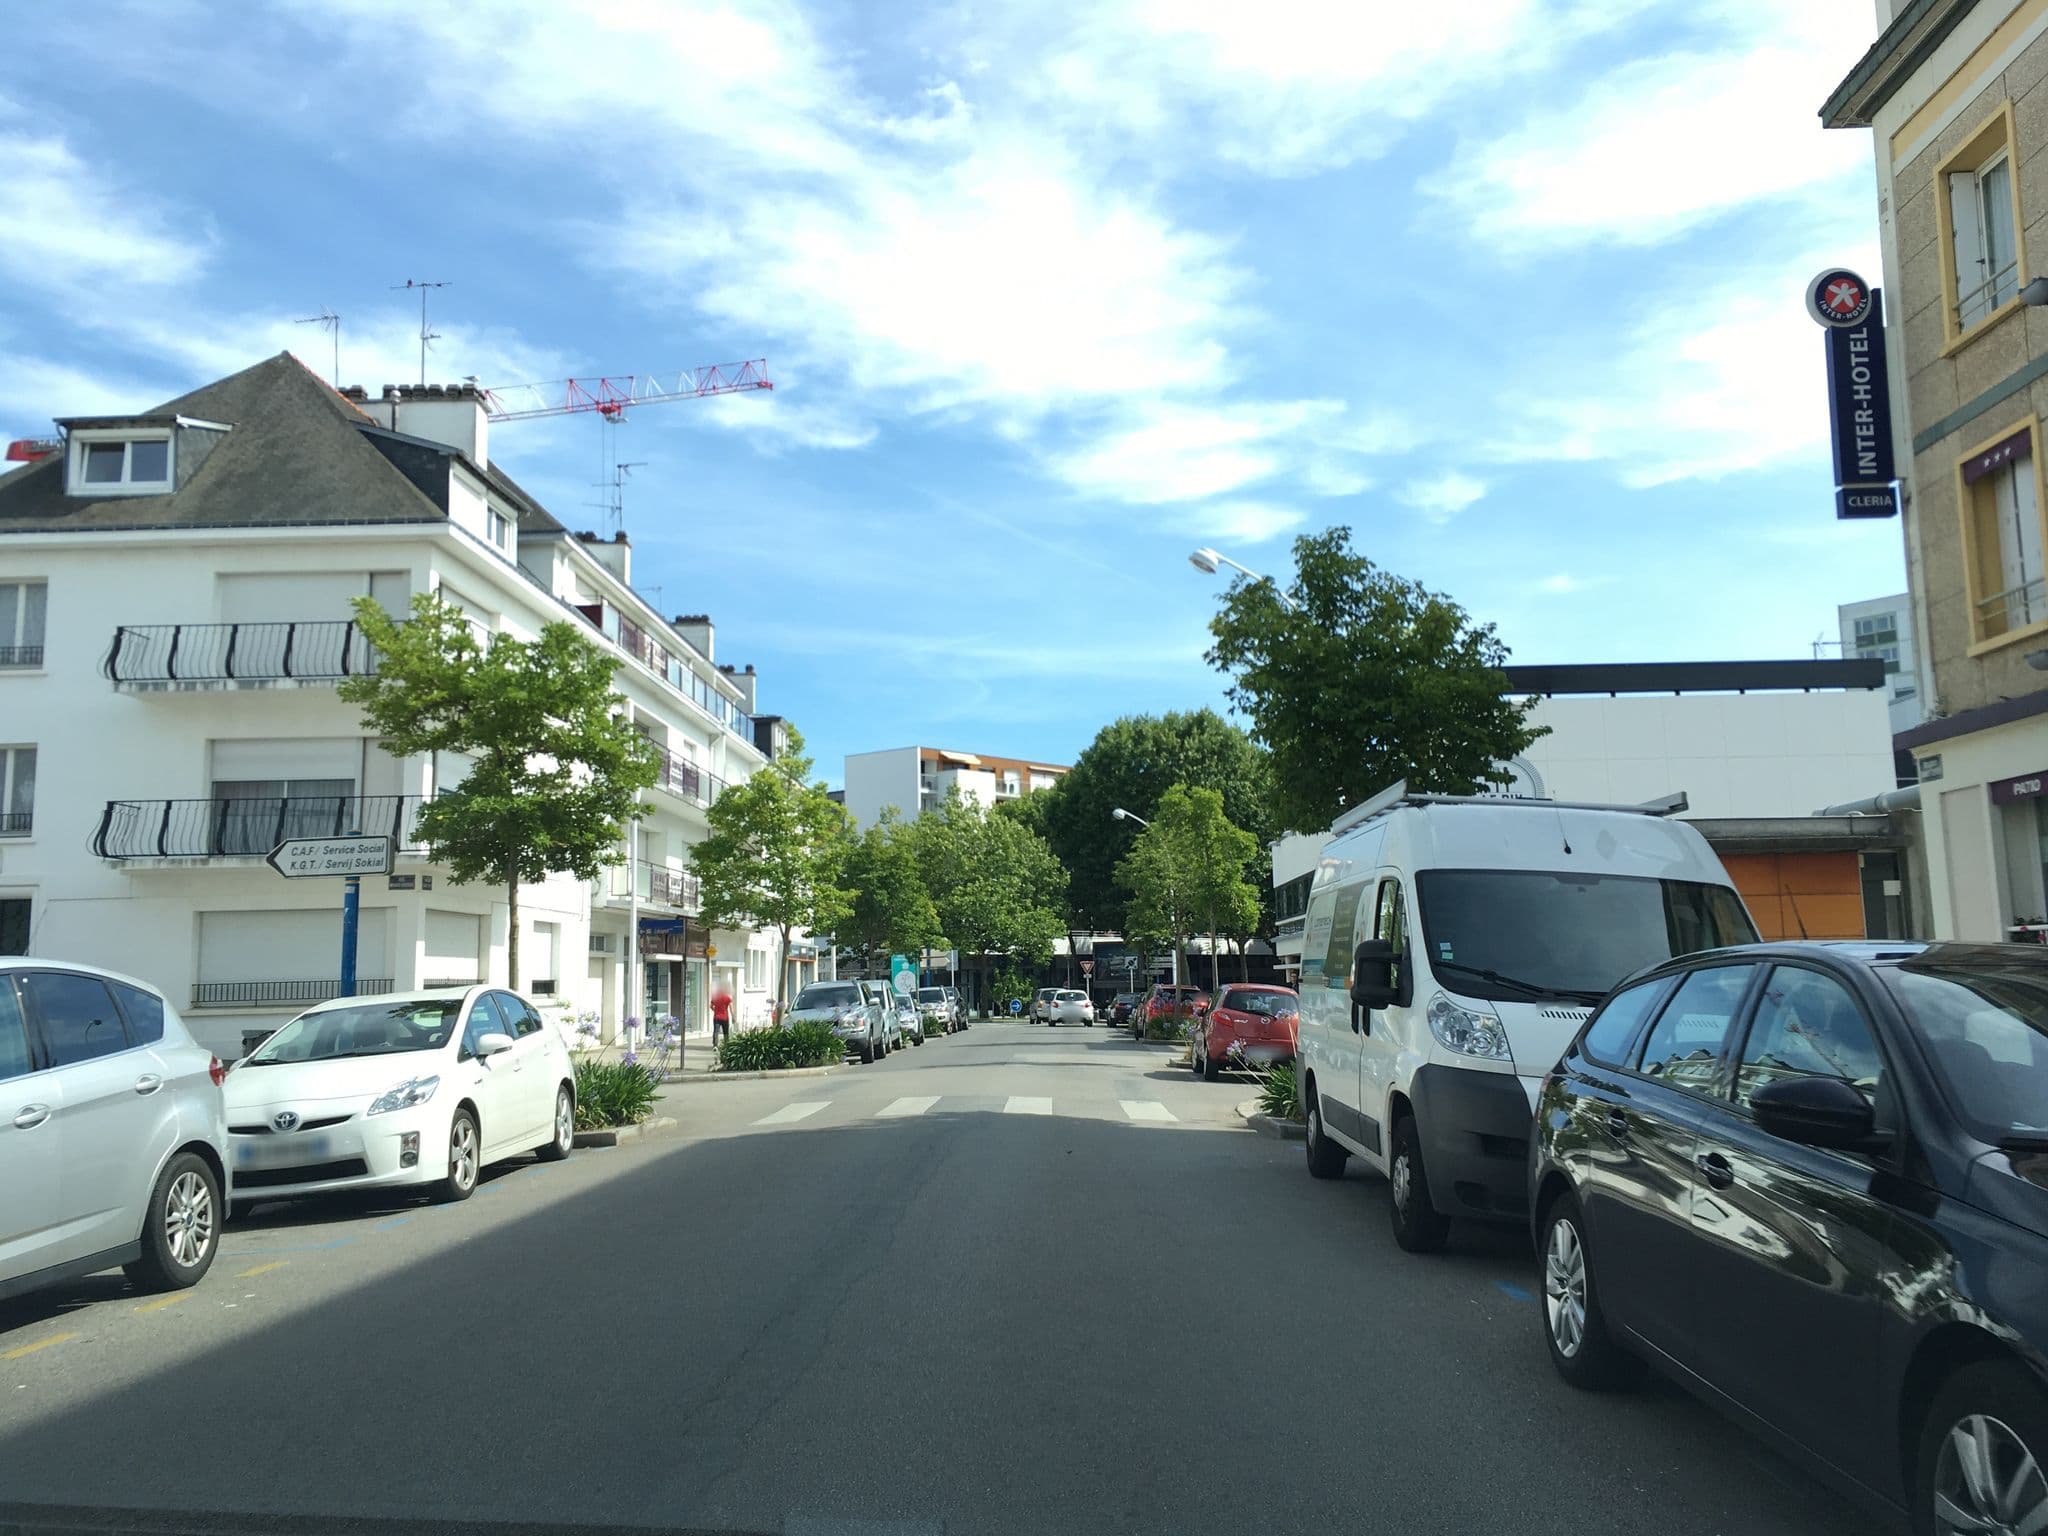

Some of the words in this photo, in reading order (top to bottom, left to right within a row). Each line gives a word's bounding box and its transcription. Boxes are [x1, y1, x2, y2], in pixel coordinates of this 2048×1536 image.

[1820, 297, 1867, 319] INTER-HOTEL
[1849, 327, 1877, 474] INTER-HOTEL
[1848, 496, 1893, 507] CLERIA
[2012, 779, 2041, 796] PATIO
[323, 844, 355, 855] Service
[357, 842, 385, 854] Social
[355, 857, 384, 868] Sokial
